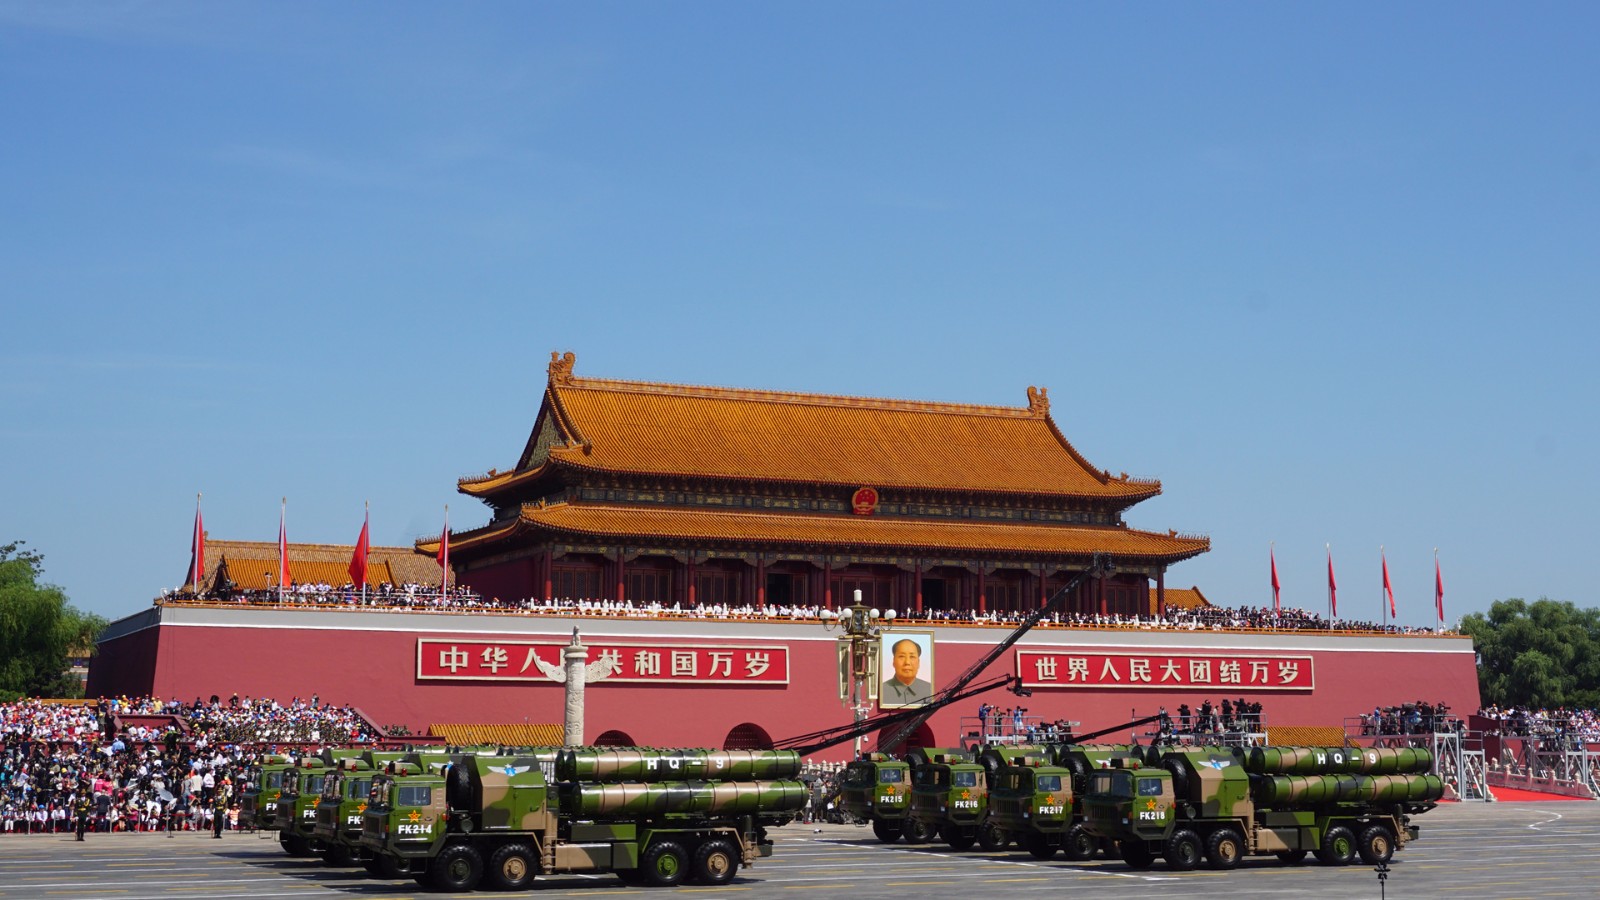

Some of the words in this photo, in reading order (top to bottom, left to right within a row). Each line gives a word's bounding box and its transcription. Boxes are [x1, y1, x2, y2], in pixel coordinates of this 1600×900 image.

[439, 646, 770, 677] 中华人共和国万岁
[1035, 657, 1299, 684] 世界人民大团结万岁
[880, 795, 903, 804] FK215
[955, 800, 978, 809] FK216
[1039, 806, 1064, 815] FK217
[1139, 811, 1165, 820] FK218
[398, 824, 432, 834] FK214
